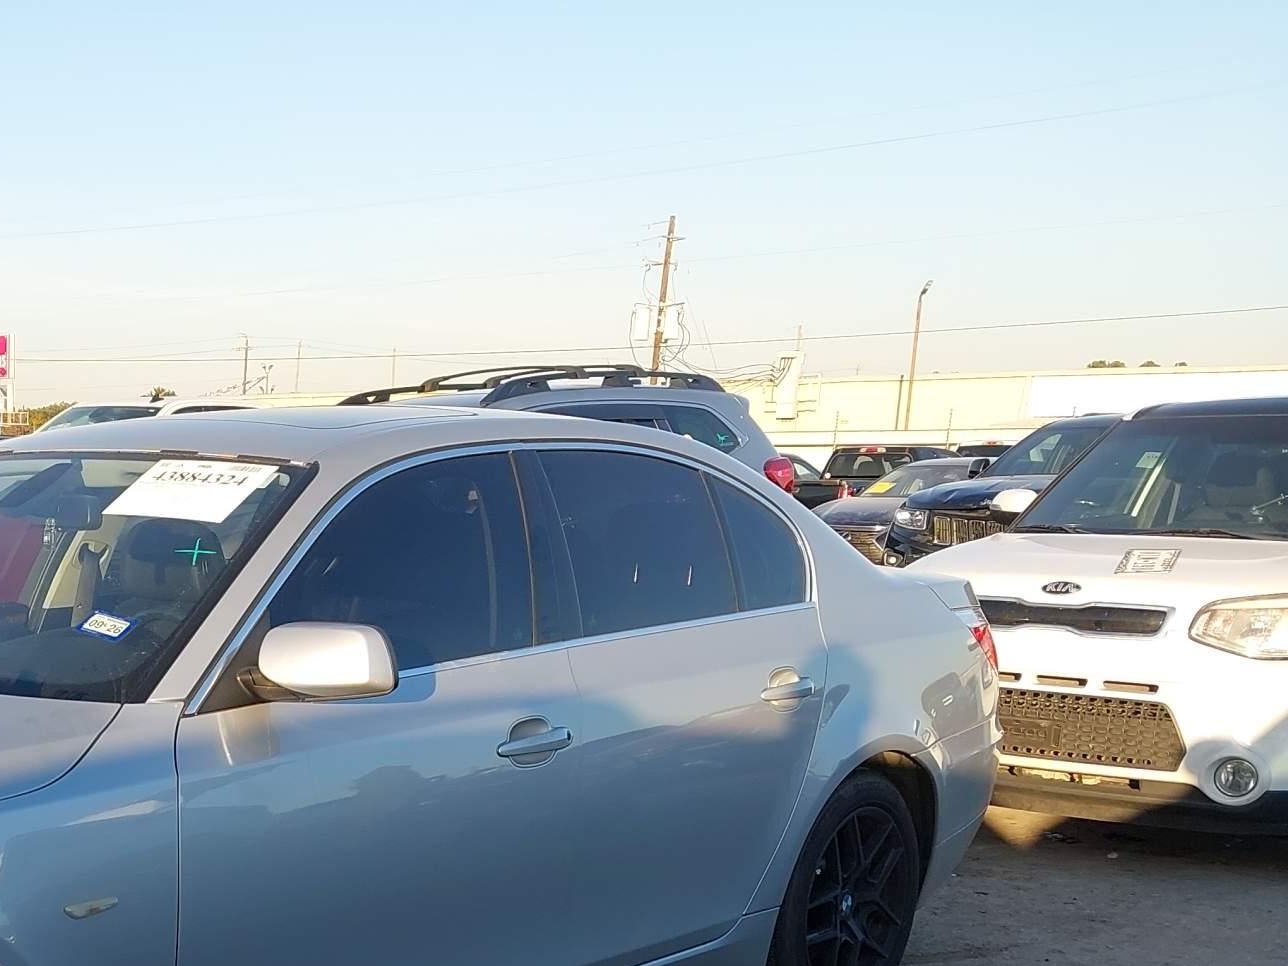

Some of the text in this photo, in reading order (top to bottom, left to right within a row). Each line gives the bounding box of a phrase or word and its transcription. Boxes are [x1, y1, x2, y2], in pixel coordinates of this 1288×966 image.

[152, 471, 249, 486] 43884324
[1045, 582, 1074, 593] KIA
[88, 619, 123, 634] 09 26
